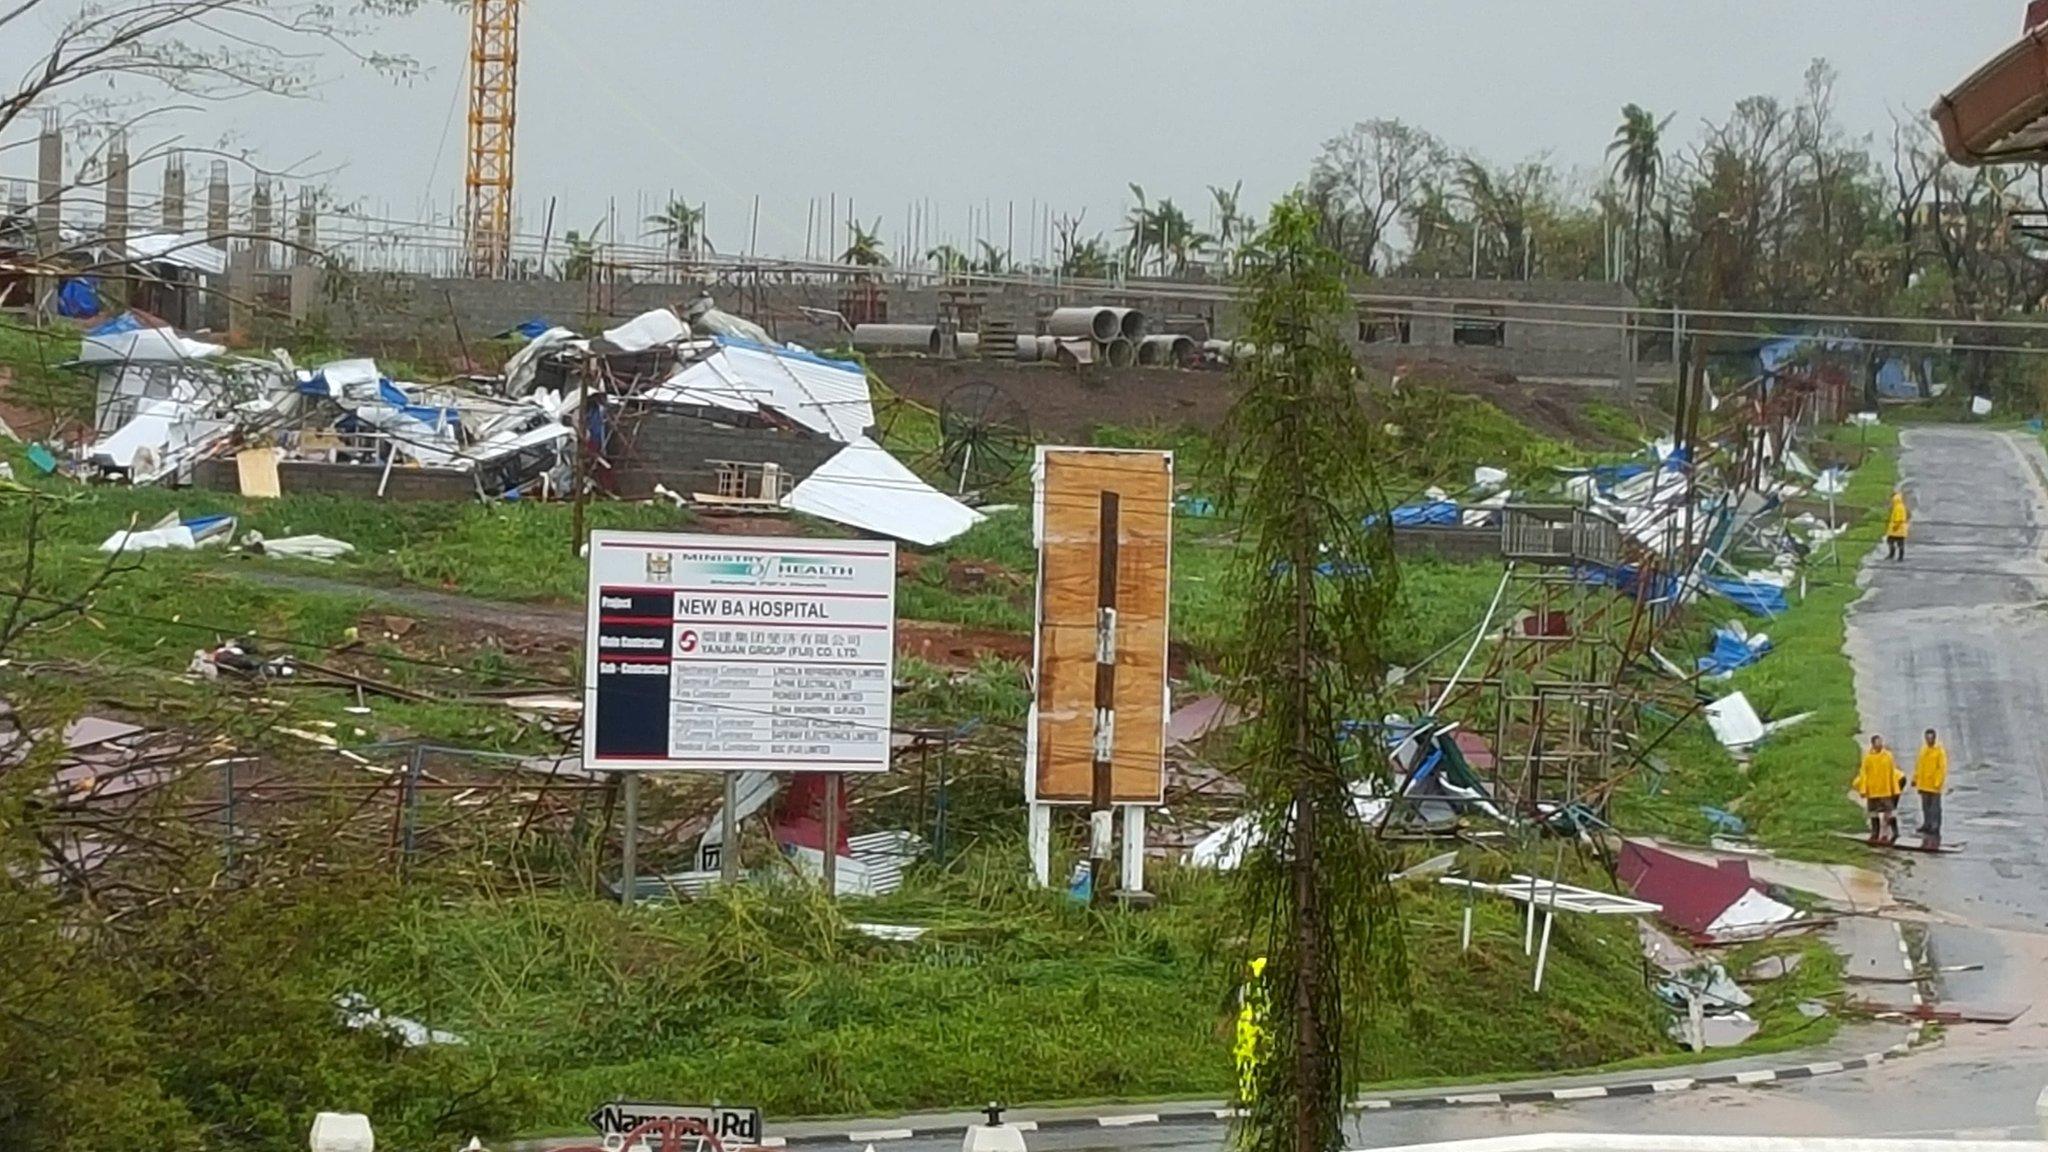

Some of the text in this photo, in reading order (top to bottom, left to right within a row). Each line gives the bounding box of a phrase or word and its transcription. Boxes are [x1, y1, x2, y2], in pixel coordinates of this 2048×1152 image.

[682, 553, 763, 563] MINISTRY
[779, 564, 853, 577] HEALTH
[678, 599, 830, 618] NEW BA HOSPITAL
[702, 644, 745, 656] YANJIAN
[749, 645, 786, 656] GROUP
[721, 1111, 755, 1138] Rd
